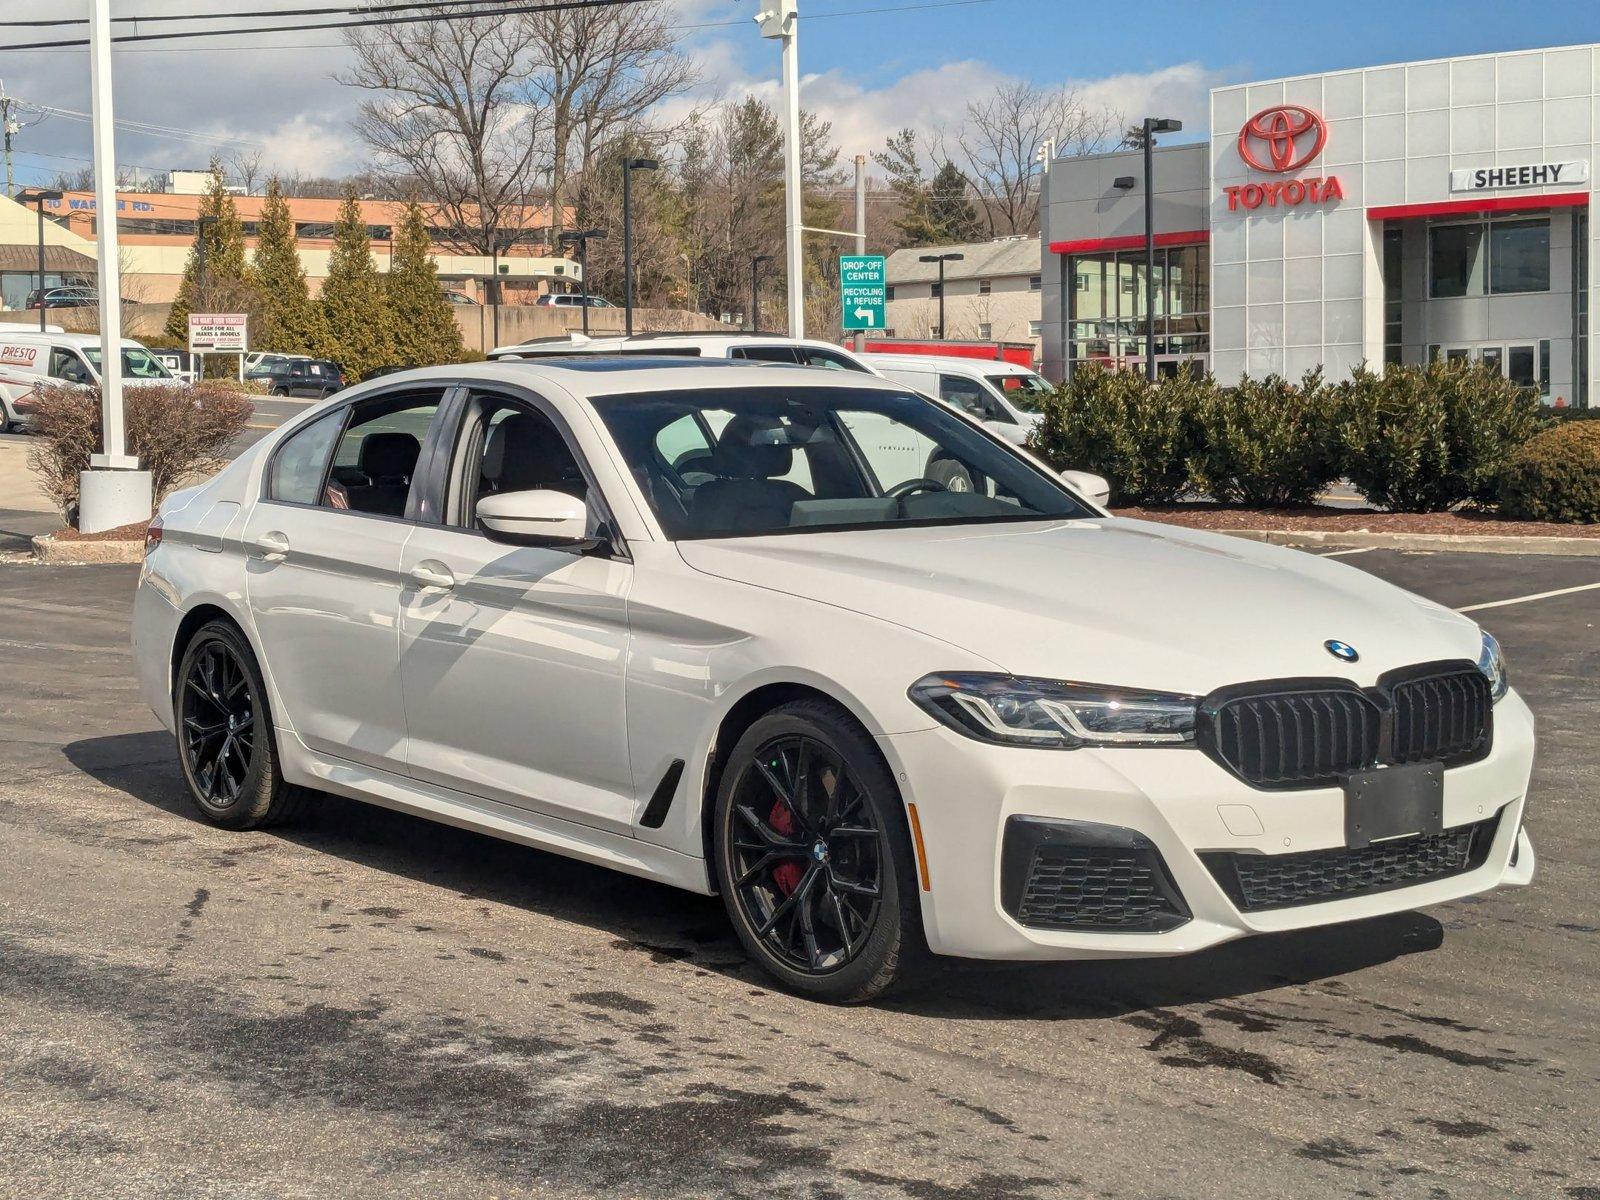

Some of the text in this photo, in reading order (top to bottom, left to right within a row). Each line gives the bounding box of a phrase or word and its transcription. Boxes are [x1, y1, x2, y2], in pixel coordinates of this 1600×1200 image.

[1475, 164, 1563, 188] SHEEHY
[1223, 175, 1344, 212] TOYOTA
[843, 261, 883, 271] DROP-OFF
[847, 272, 880, 280] CENTER
[844, 287, 884, 296] RECYCLING
[846, 297, 883, 305] & REFUSE
[1, 346, 37, 361] PRESTO
